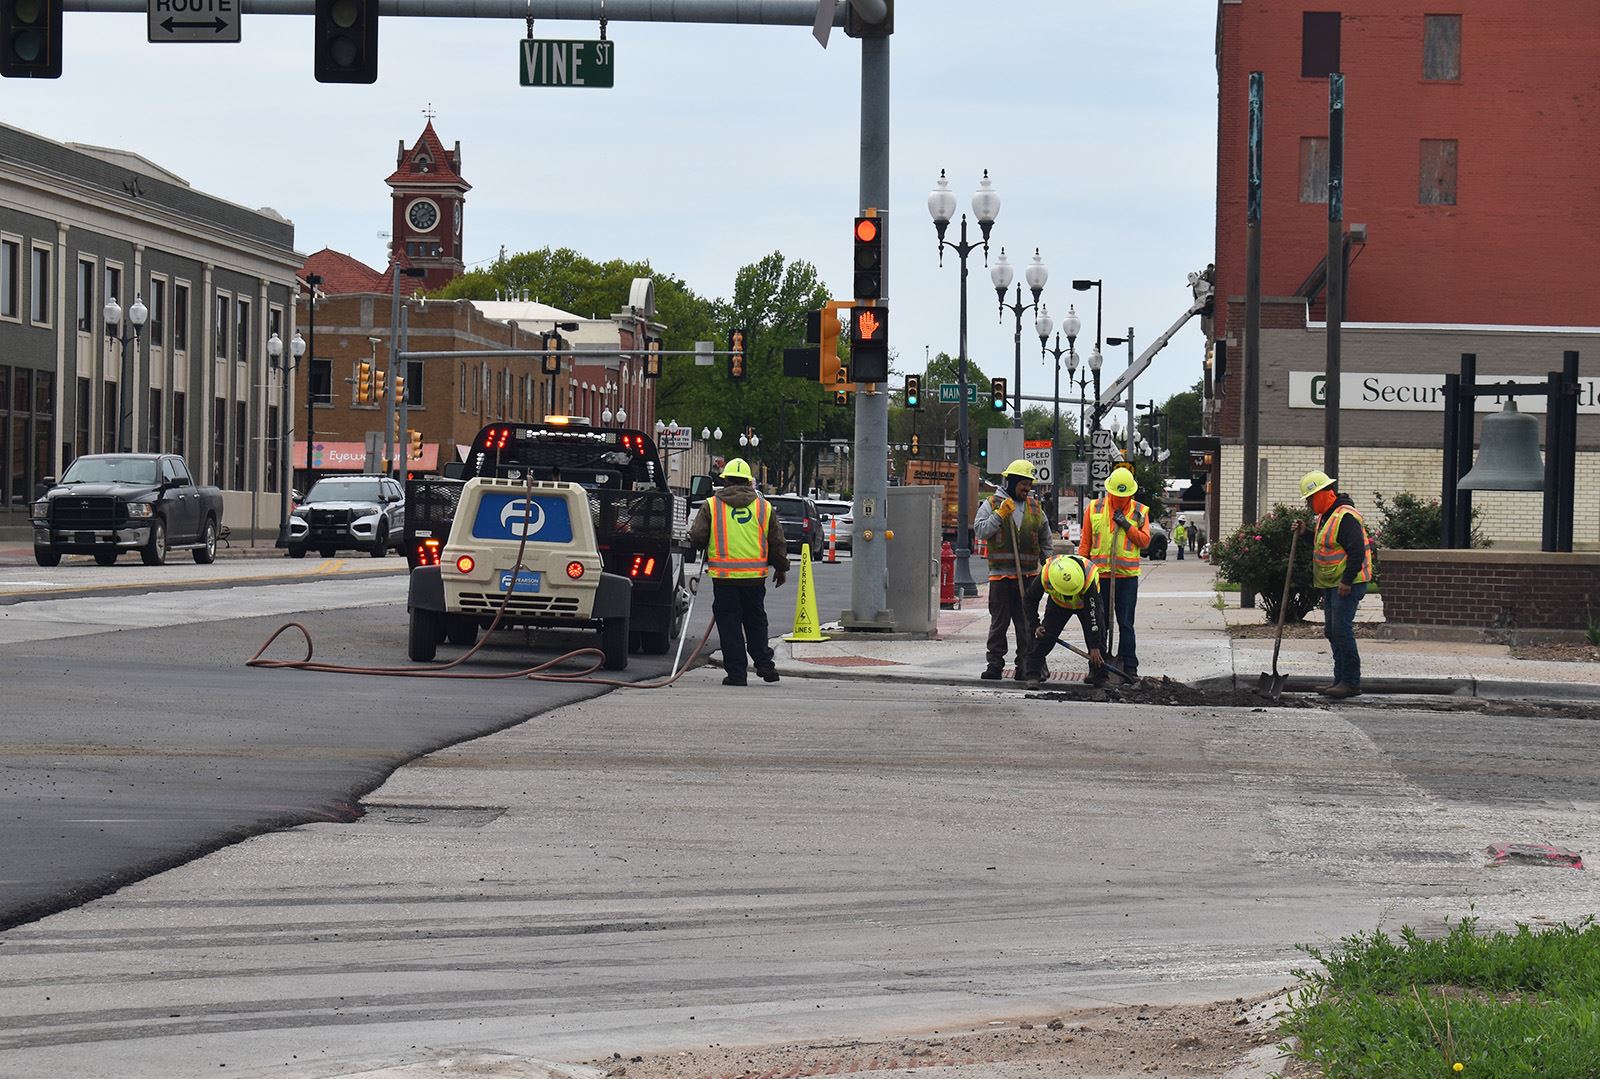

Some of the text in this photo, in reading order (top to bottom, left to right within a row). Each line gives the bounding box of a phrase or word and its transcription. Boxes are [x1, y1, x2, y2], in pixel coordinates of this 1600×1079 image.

[156, 0, 232, 12] ROUTE
[524, 42, 610, 85] VINE ST
[1094, 433, 1109, 444] 77
[1093, 464, 1109, 475] 54
[795, 626, 812, 634] LINES
